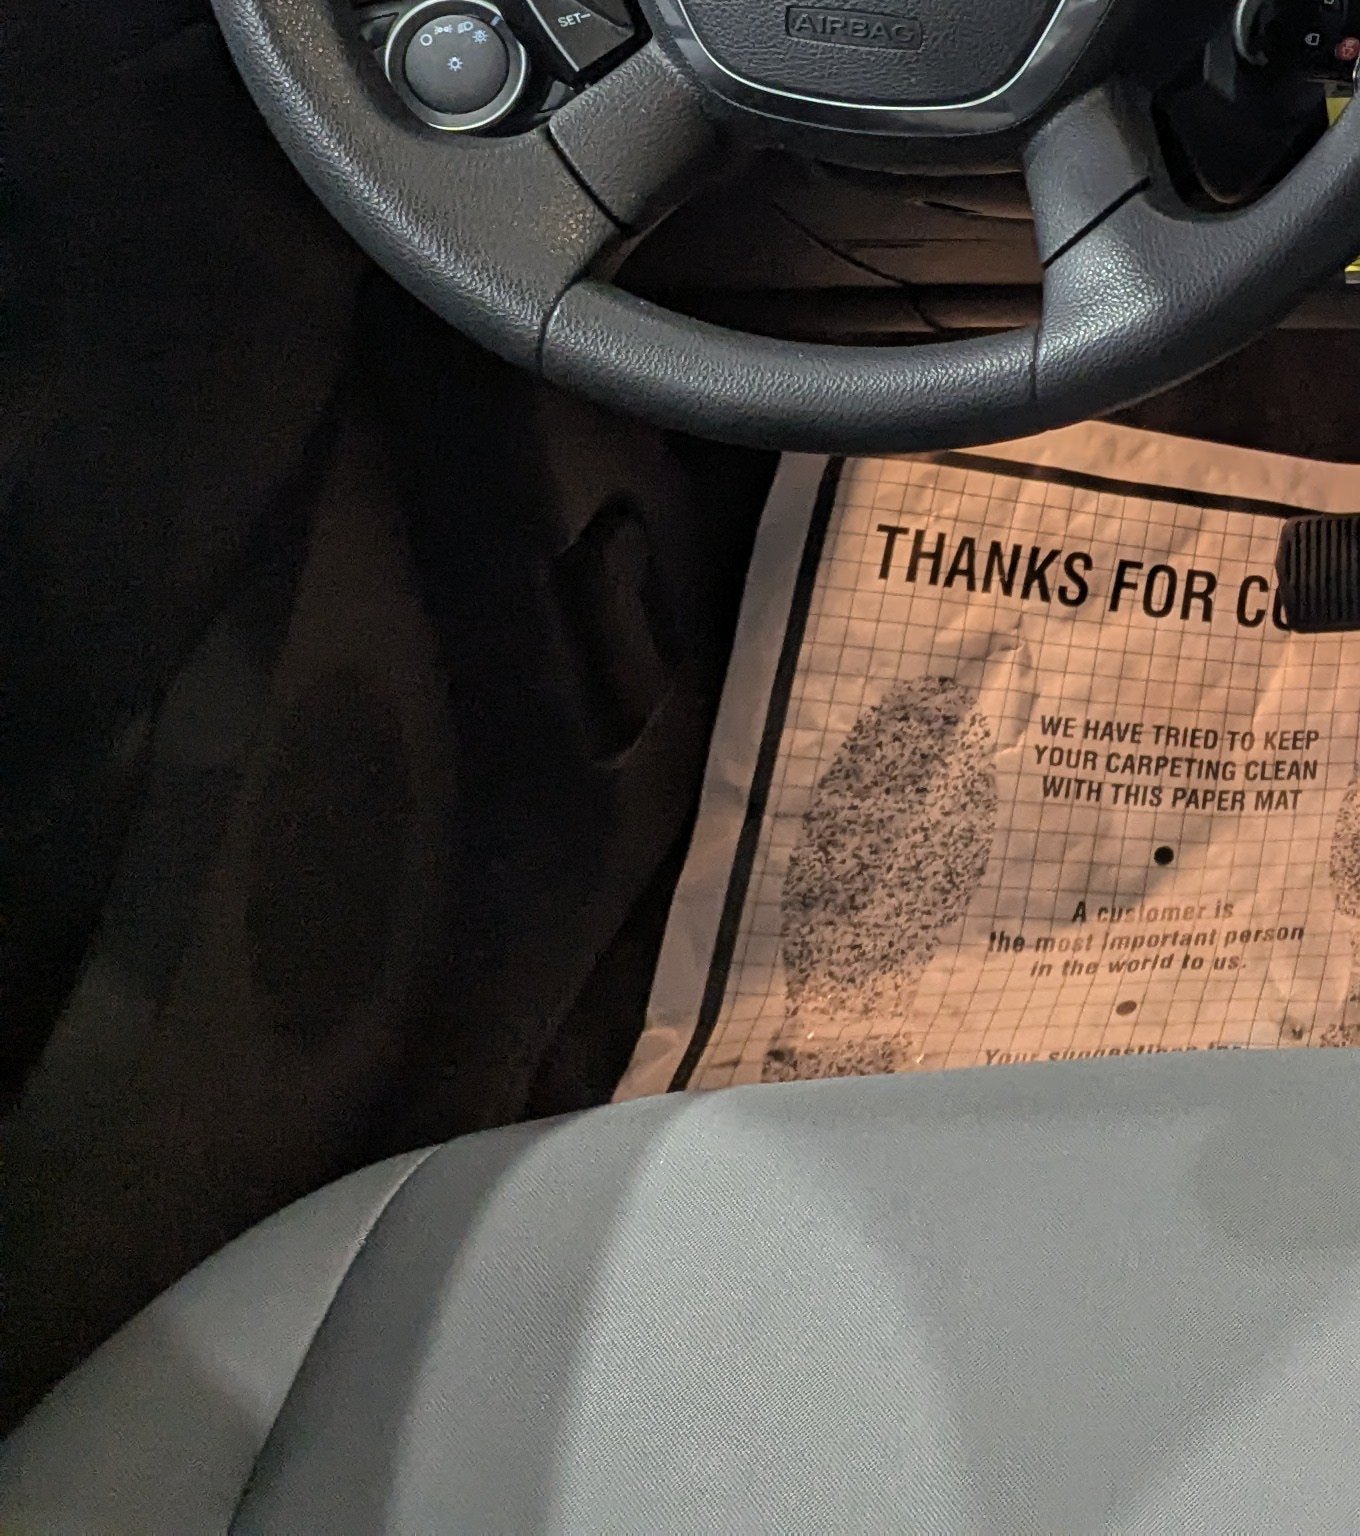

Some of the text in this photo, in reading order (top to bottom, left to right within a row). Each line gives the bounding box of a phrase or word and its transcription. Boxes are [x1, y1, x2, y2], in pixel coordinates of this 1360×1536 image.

[793, 13, 916, 42] AIRBAG
[876, 523, 1094, 608] THANKS
[1108, 558, 1217, 623] FOR
[1041, 715, 1319, 752] WE HAVE TRIED TO KEEP
[1034, 744, 1318, 781] YOUR CARPETING CLEAN
[1043, 775, 1303, 812] WITH THIS PAPER MAT
[1072, 899, 1235, 923] A customer is
[988, 931, 1026, 953] the
[1035, 933, 1094, 953] most
[1224, 926, 1305, 948] person
[1030, 953, 1246, 977] in the world to us.
